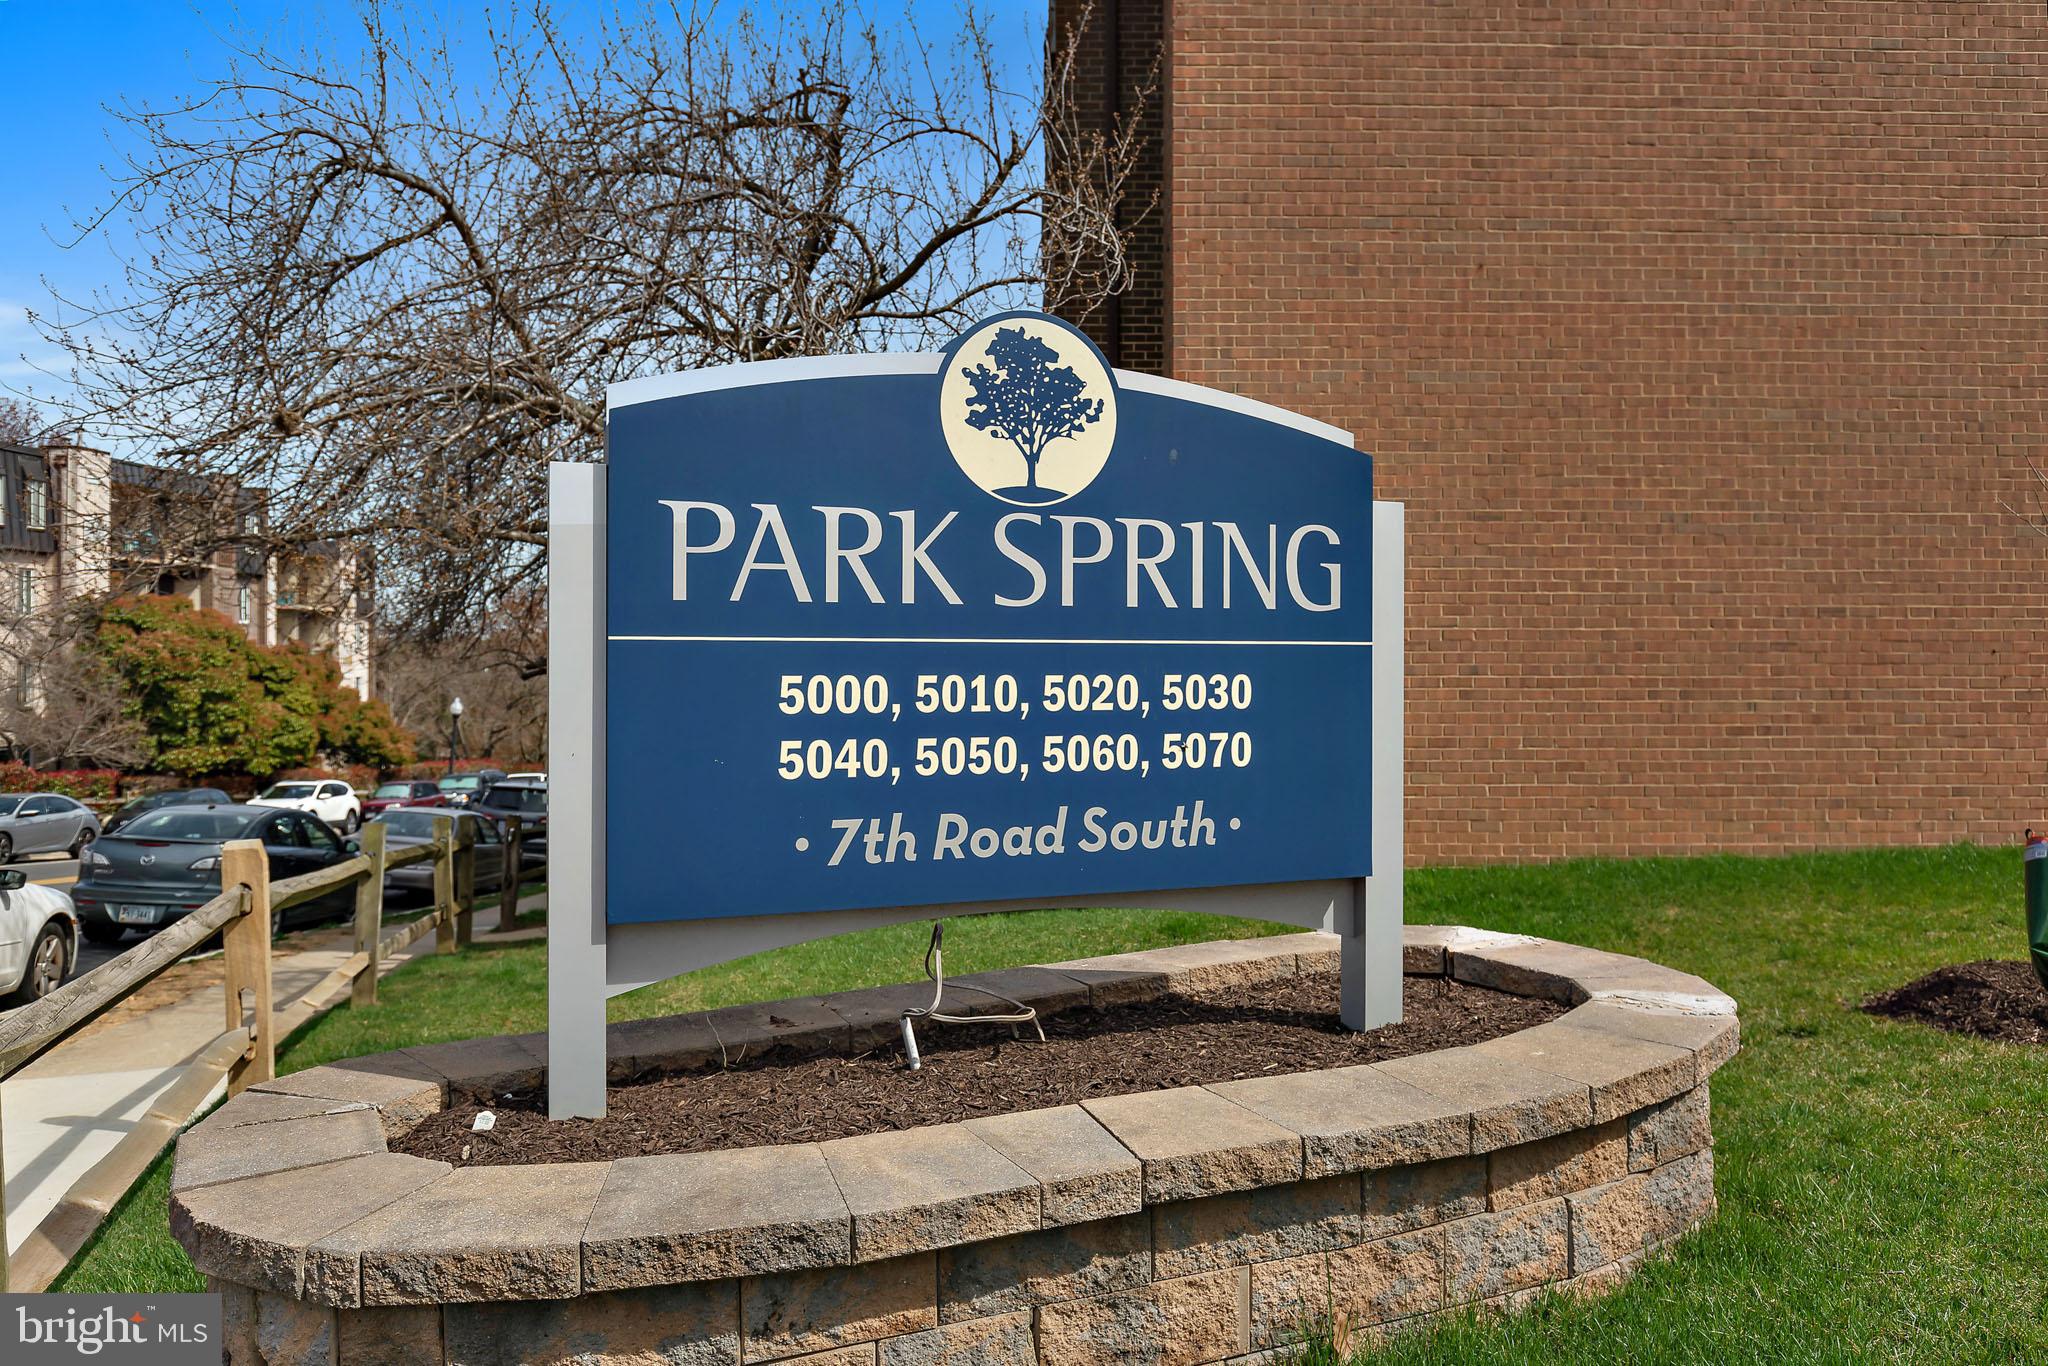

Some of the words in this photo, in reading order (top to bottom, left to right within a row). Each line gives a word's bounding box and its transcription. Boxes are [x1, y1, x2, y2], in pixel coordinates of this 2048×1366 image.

[657, 499, 964, 605] PARK
[993, 512, 1342, 612] SPRING
[778, 674, 901, 722] 5000,
[914, 674, 1030, 721] 5010,
[1042, 673, 1150, 719] 5020,
[1161, 672, 1253, 712] 5030
[777, 733, 901, 786] 5040,
[914, 734, 1030, 782] 5050,
[1041, 732, 1150, 778] 5060,
[1161, 730, 1253, 770] 5070
[827, 811, 918, 867] 7th
[932, 804, 1069, 861] Road
[1077, 799, 1217, 853] South
